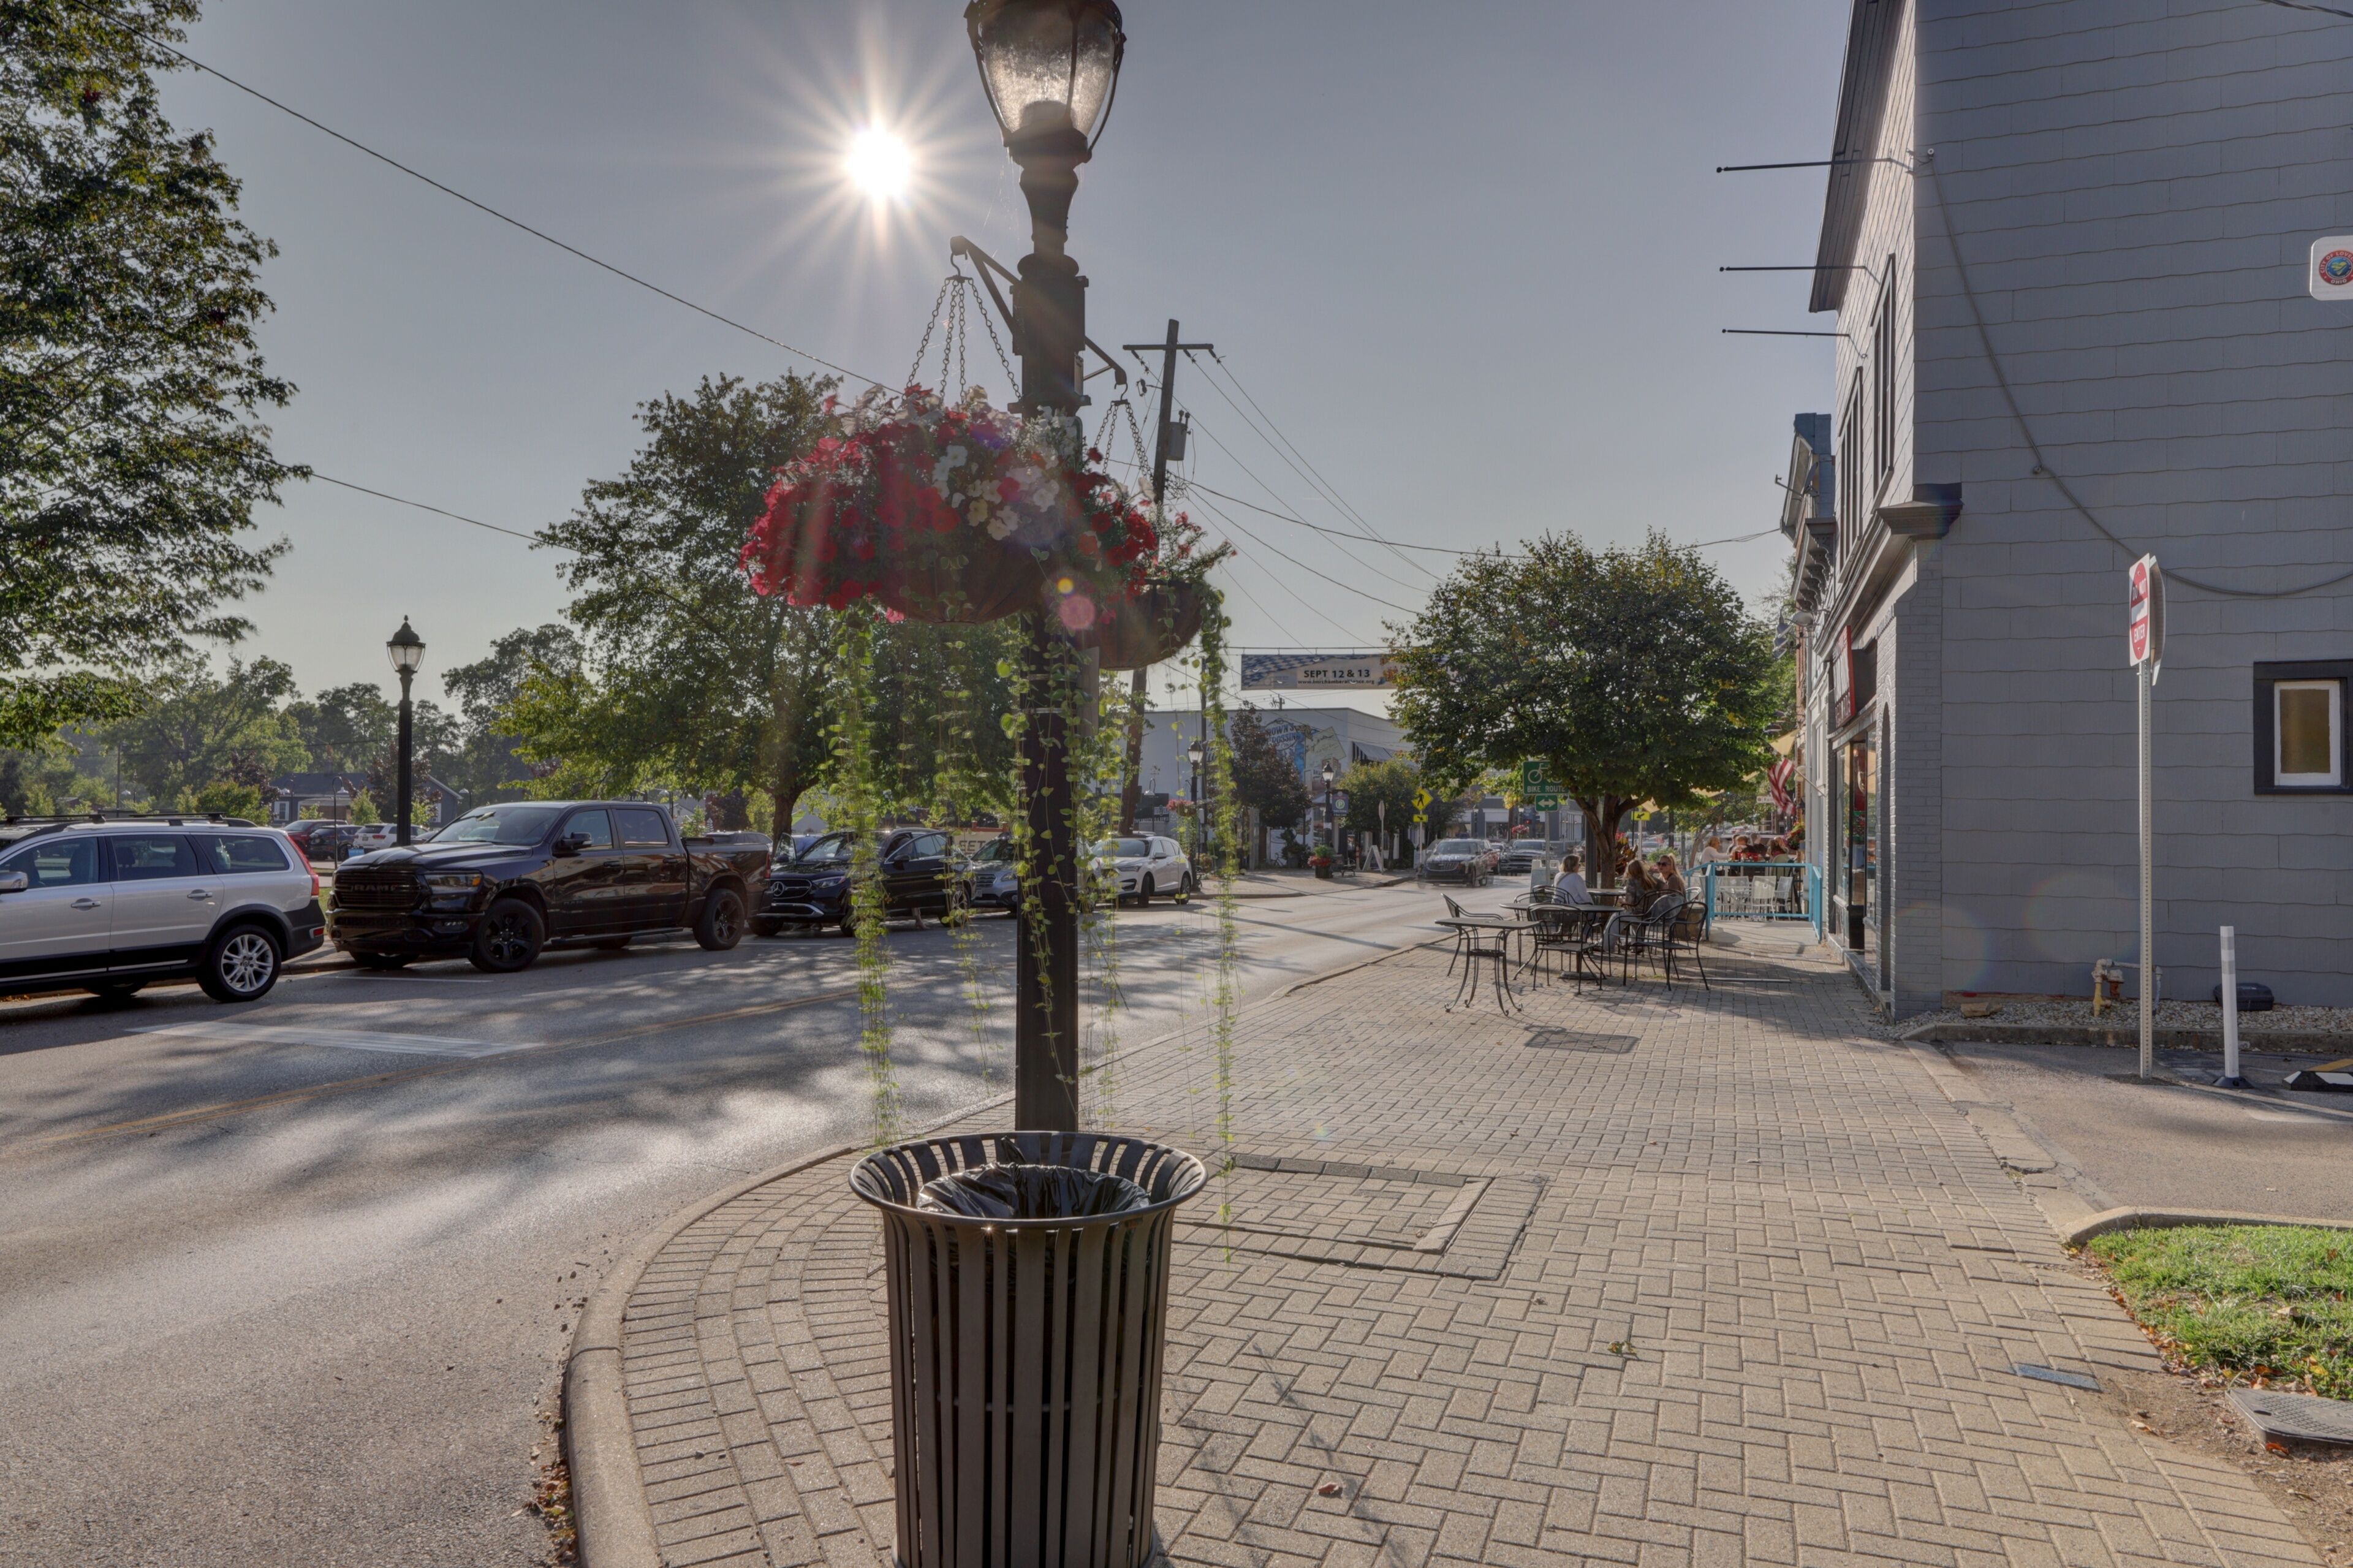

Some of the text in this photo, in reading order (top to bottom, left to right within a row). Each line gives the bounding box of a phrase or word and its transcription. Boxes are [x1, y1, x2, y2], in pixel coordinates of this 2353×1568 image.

[2132, 586, 2138, 600] DO
[2134, 624, 2145, 643] ENTER
[1346, 669, 1355, 678] &
[1357, 669, 1370, 678] 13
